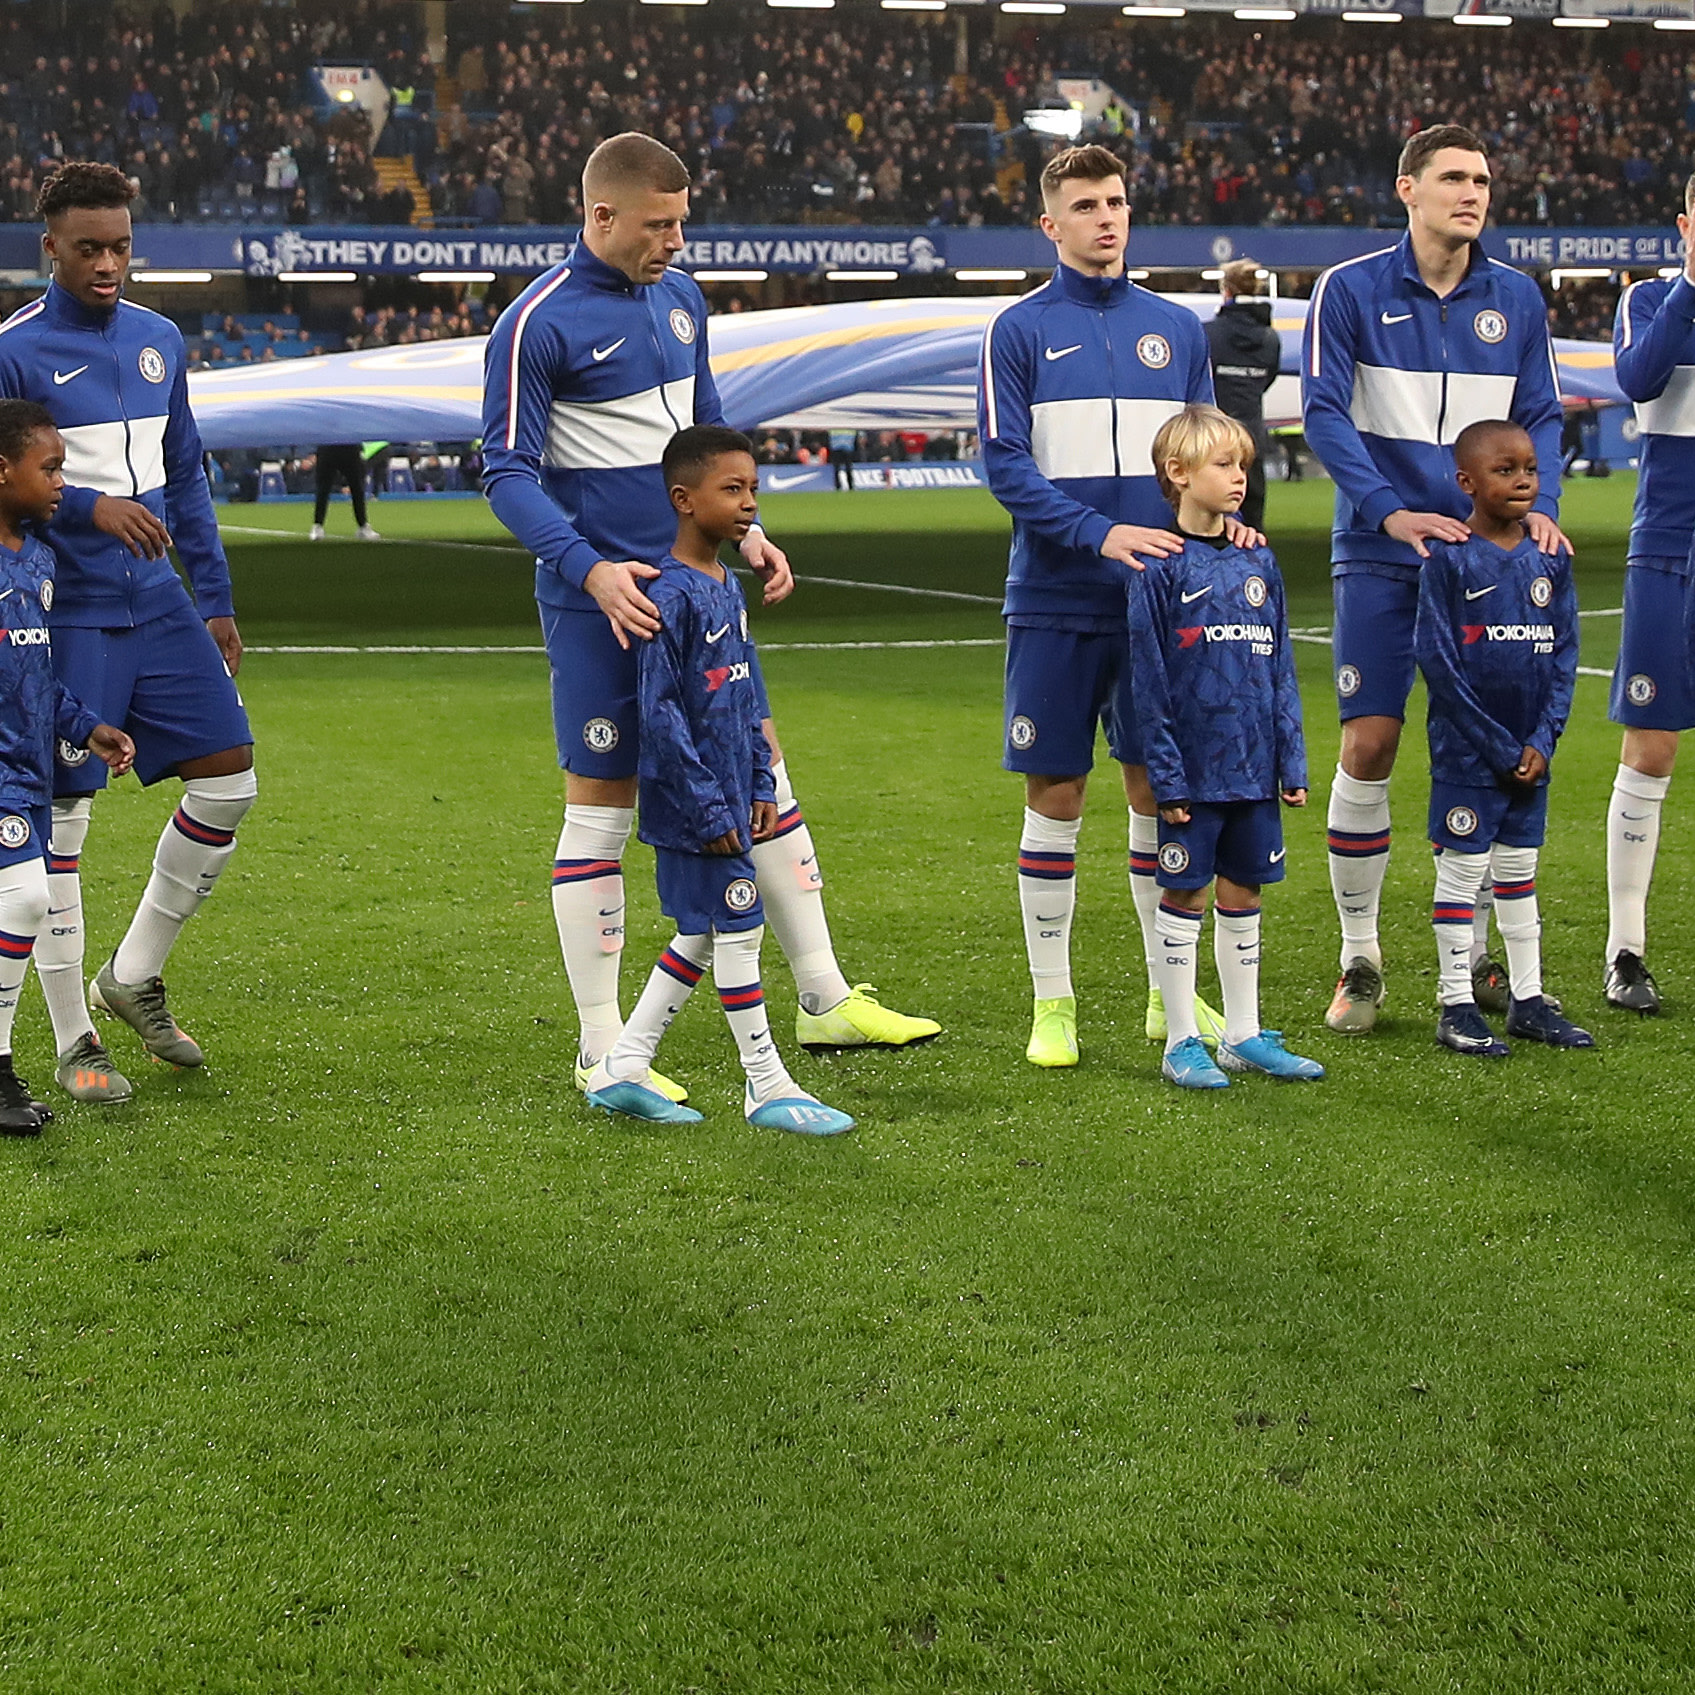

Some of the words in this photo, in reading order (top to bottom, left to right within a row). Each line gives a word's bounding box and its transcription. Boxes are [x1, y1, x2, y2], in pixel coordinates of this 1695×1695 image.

[311, 240, 389, 265] THEY
[480, 241, 566, 267] MAKE
[670, 240, 712, 264] KE
[715, 241, 772, 264] RAY
[771, 241, 909, 266] ANYMORE
[1506, 237, 1553, 260] THE
[1559, 237, 1631, 260] PRIDE
[1635, 238, 1659, 260] OF
[890, 467, 982, 488] FOOTBALL
[8, 628, 50, 646] YOKOH
[1623, 831, 1647, 843] CFC
[51, 925, 78, 937] CFC
[1039, 929, 1063, 939] CFC
[1165, 956, 1189, 966] CFC
